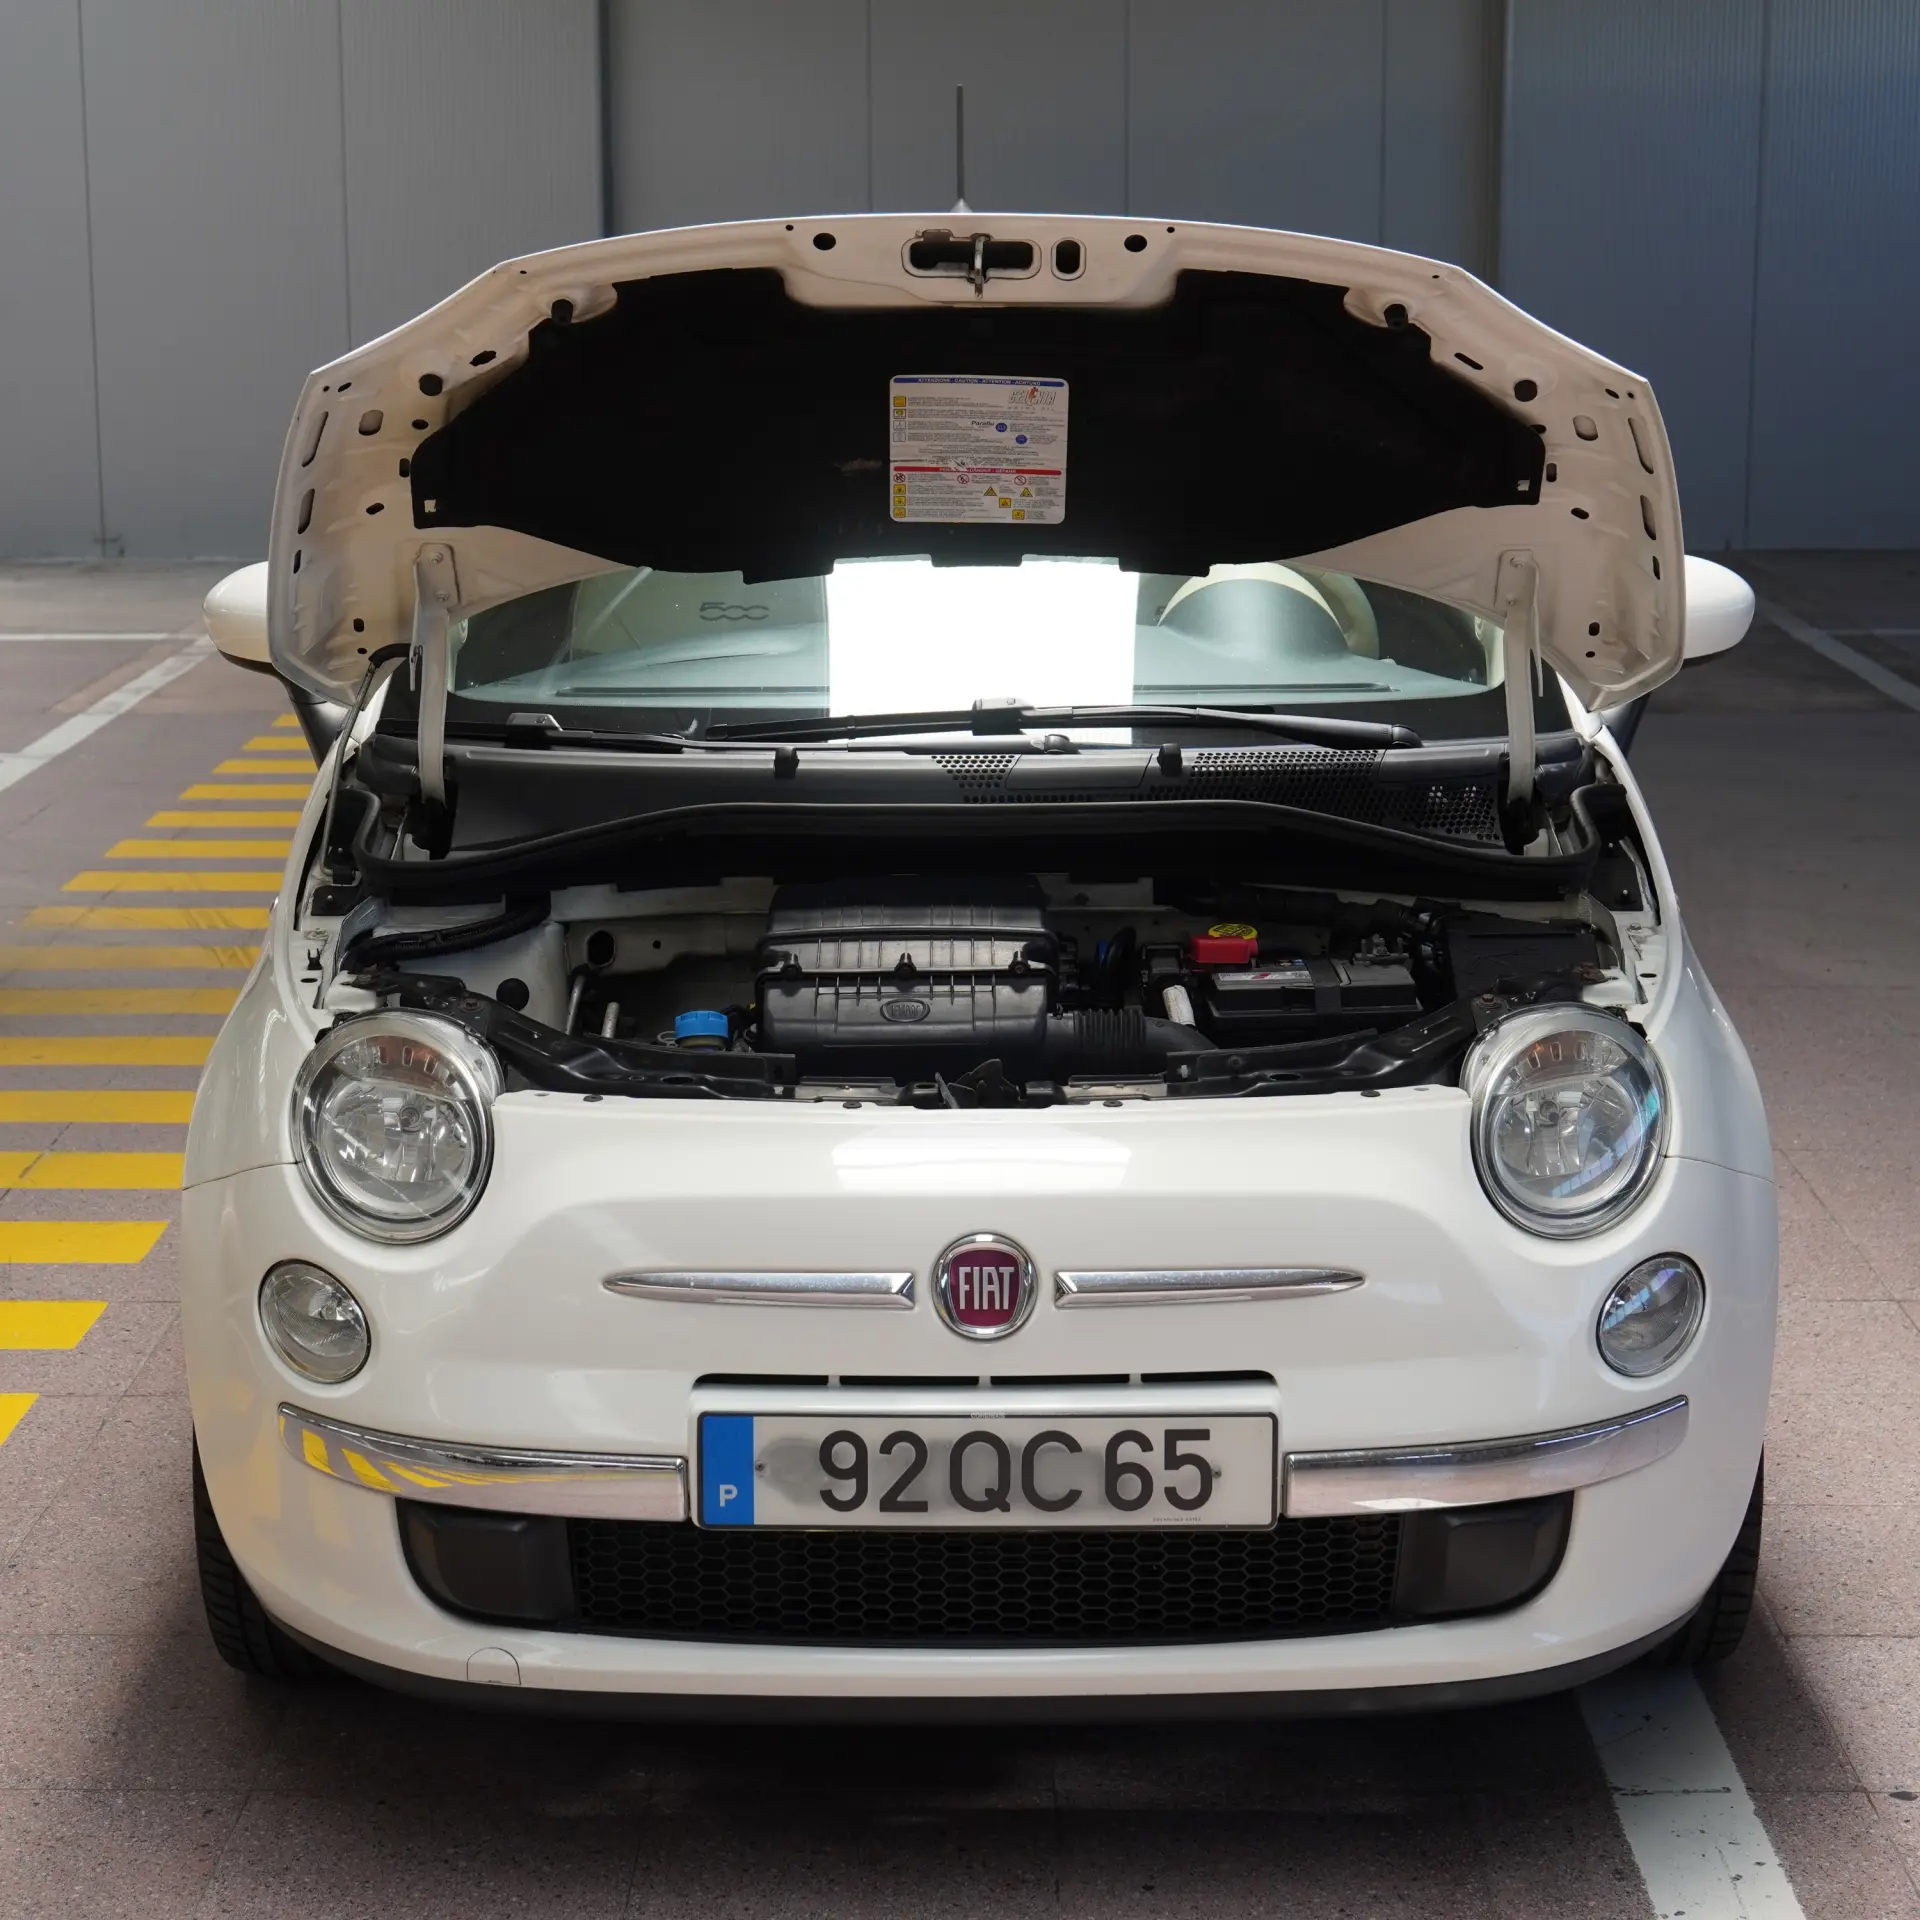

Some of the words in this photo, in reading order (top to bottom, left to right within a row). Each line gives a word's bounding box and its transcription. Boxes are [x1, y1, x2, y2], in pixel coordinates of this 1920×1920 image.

[699, 601, 770, 621] 500
[958, 1266, 1015, 1310] FIAT
[818, 1430, 928, 1513] 92
[948, 1430, 1083, 1513] QC
[1104, 1428, 1213, 1512] 65
[718, 1484, 738, 1508] P
